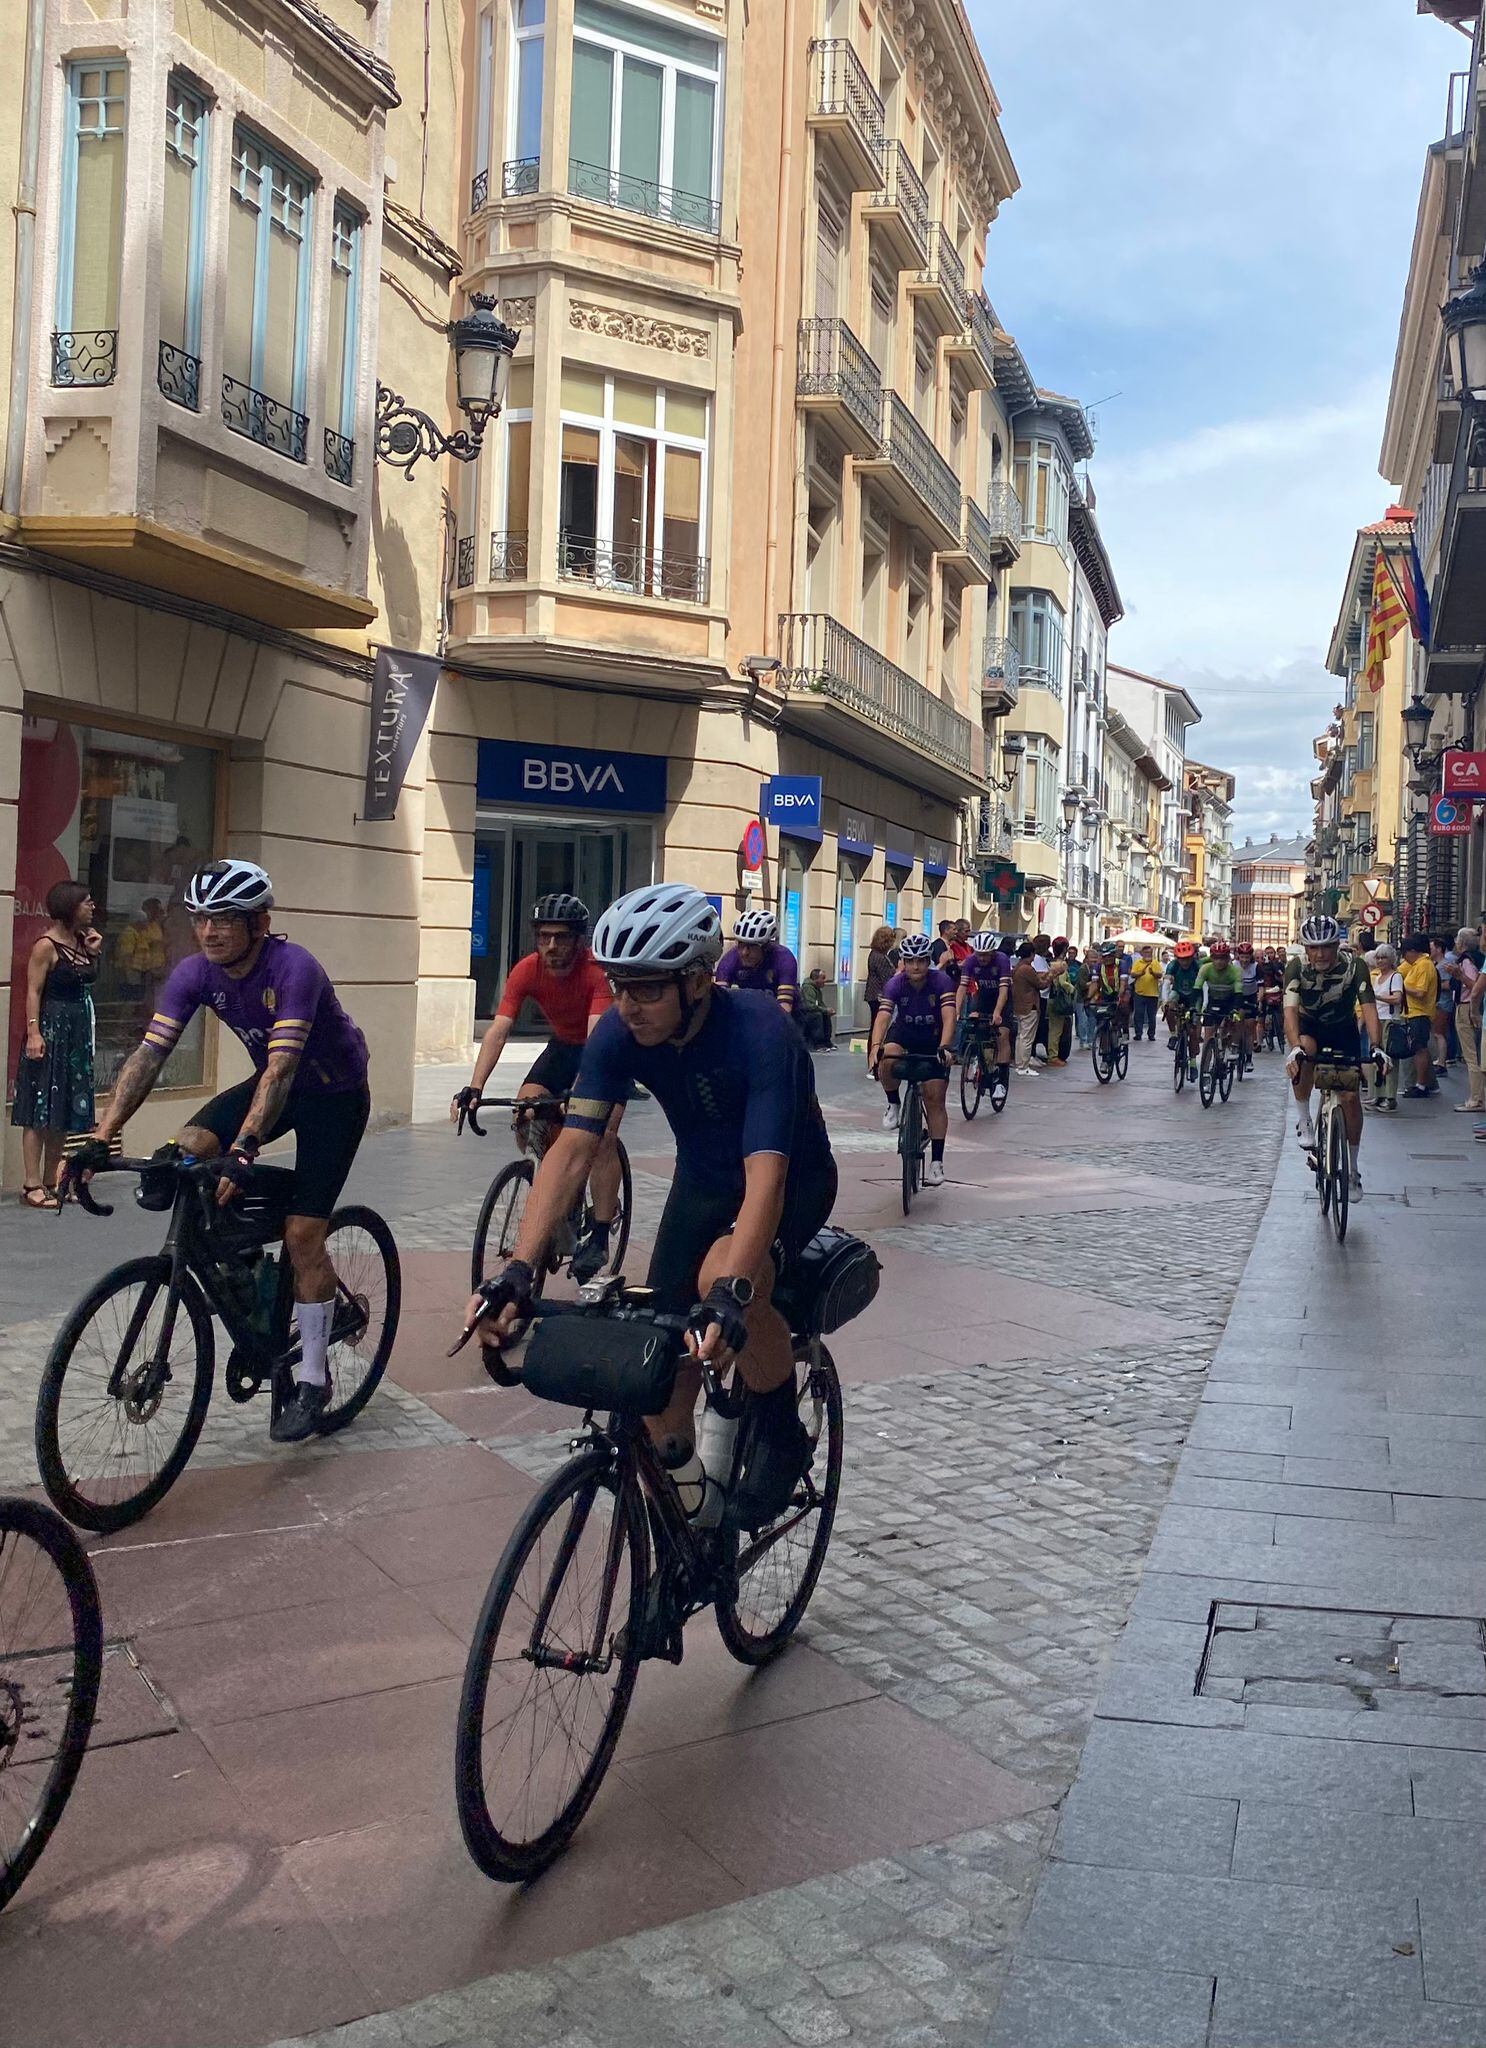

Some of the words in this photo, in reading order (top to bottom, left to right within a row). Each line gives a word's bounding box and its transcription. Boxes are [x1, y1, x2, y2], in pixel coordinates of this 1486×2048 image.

[524, 759, 624, 793] BBVA
[1452, 762, 1479, 776] CA
[774, 793, 815, 807] BBVA
[846, 817, 868, 843] BBVA
